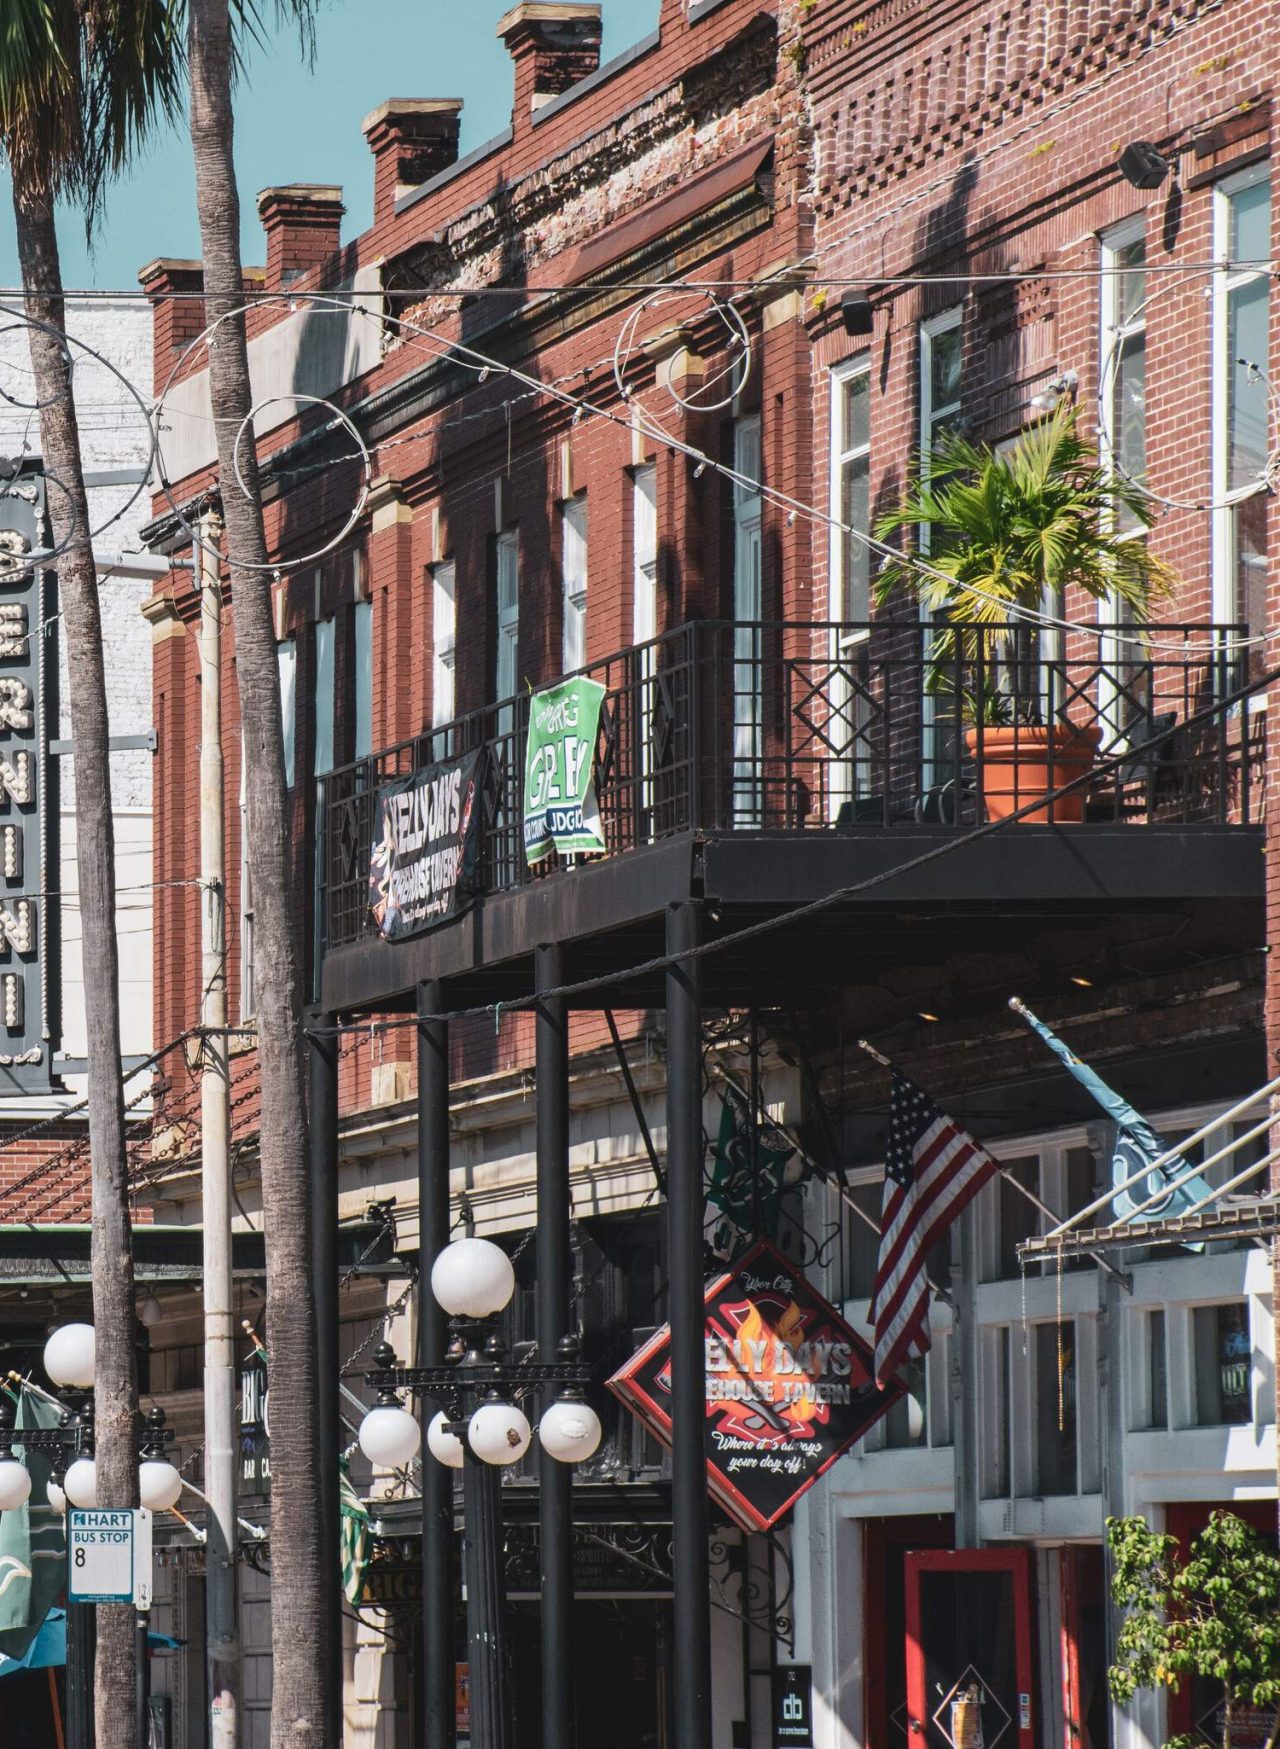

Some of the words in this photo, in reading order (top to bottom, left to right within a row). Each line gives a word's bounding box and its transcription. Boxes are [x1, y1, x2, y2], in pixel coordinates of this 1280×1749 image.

[429, 768, 461, 841] DAYS
[773, 1275, 795, 1294] City
[704, 1338, 768, 1375] ELLY
[774, 1341, 852, 1376] DAYS
[705, 1378, 775, 1402] EHOUSE
[782, 1382, 850, 1404] TAVERN
[712, 1431, 754, 1450] Where
[244, 1459, 255, 1479] BAR
[727, 1457, 758, 1472] your
[760, 1454, 784, 1474] day
[88, 1514, 129, 1526] HART
[74, 1532, 96, 1543] BUS
[99, 1532, 129, 1543] STOP
[75, 1547, 86, 1568] 8
